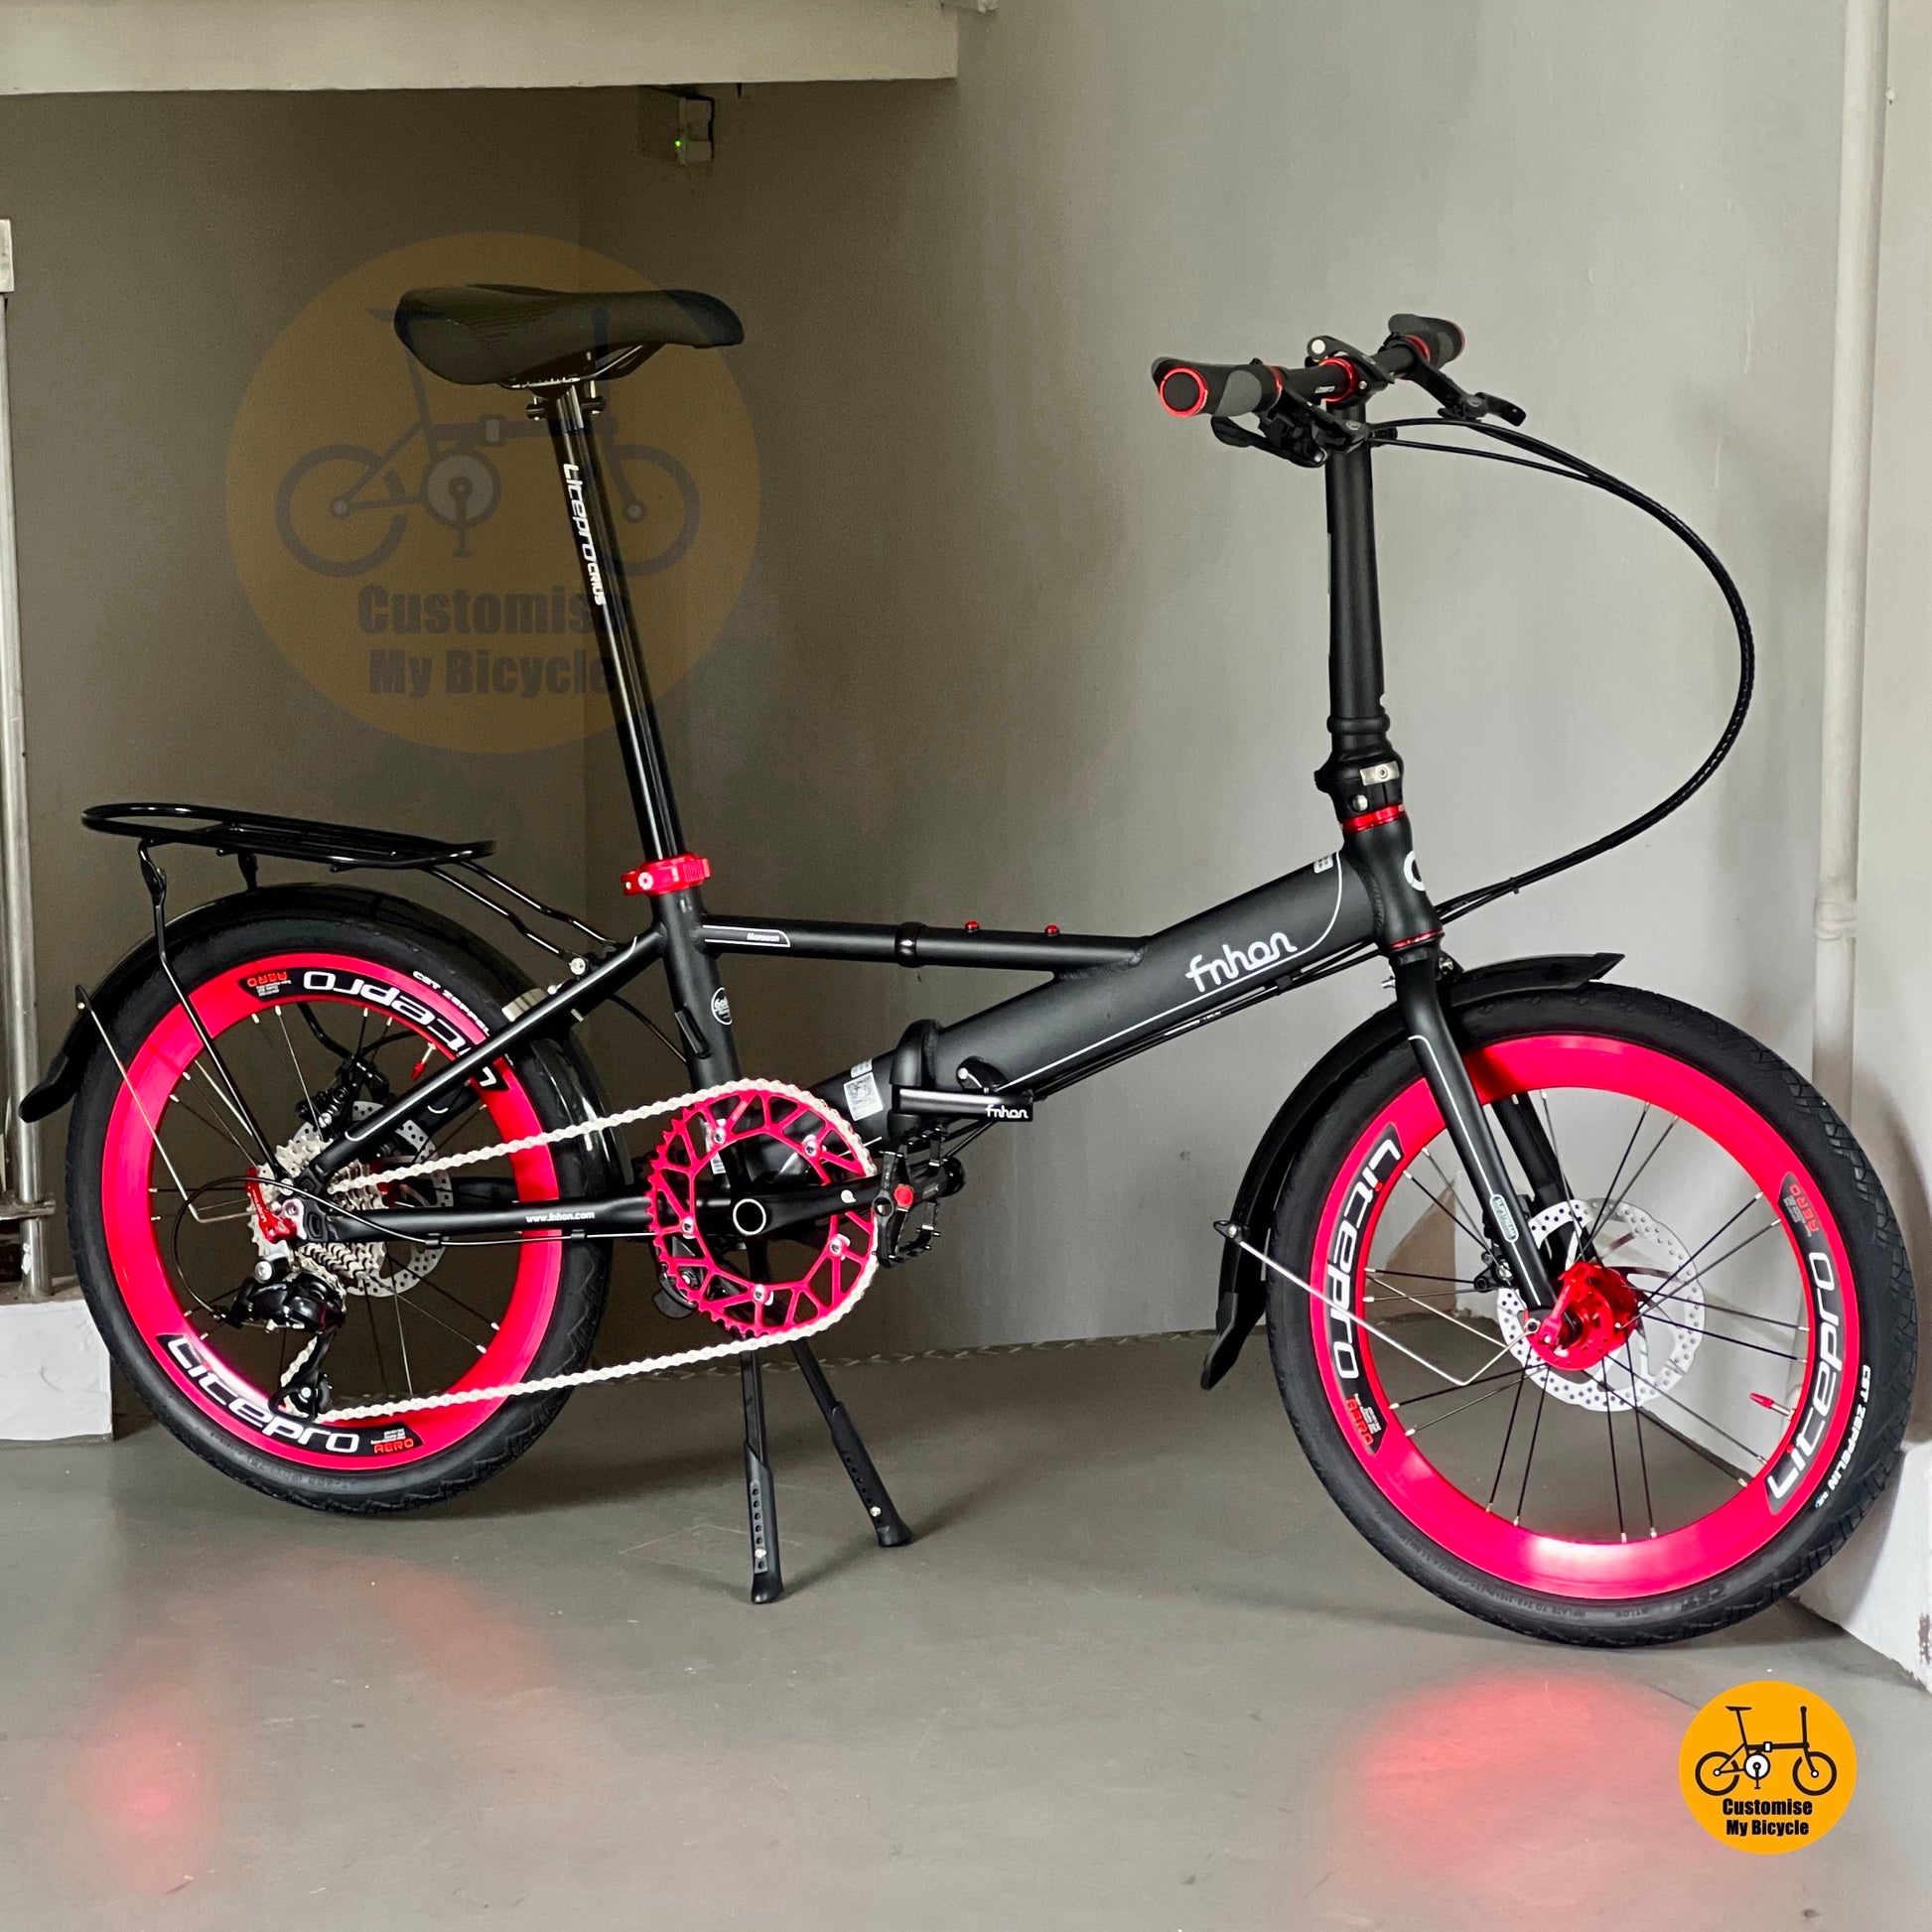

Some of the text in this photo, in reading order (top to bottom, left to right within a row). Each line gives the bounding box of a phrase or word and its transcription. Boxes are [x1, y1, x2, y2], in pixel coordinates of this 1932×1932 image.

[247, 971, 287, 988] AERO
[1185, 932, 1298, 992] fnhon
[442, 989, 490, 1037] ZEPPEL
[985, 1104, 1029, 1119] fnhon
[525, 1211, 595, 1223] www.fnhon.com
[1788, 1183, 1820, 1232] AERO
[1345, 1396, 1375, 1446] AERO
[1828, 1363, 1872, 1491] CST ZEPPELIN
[373, 1438, 415, 1454] AERO
